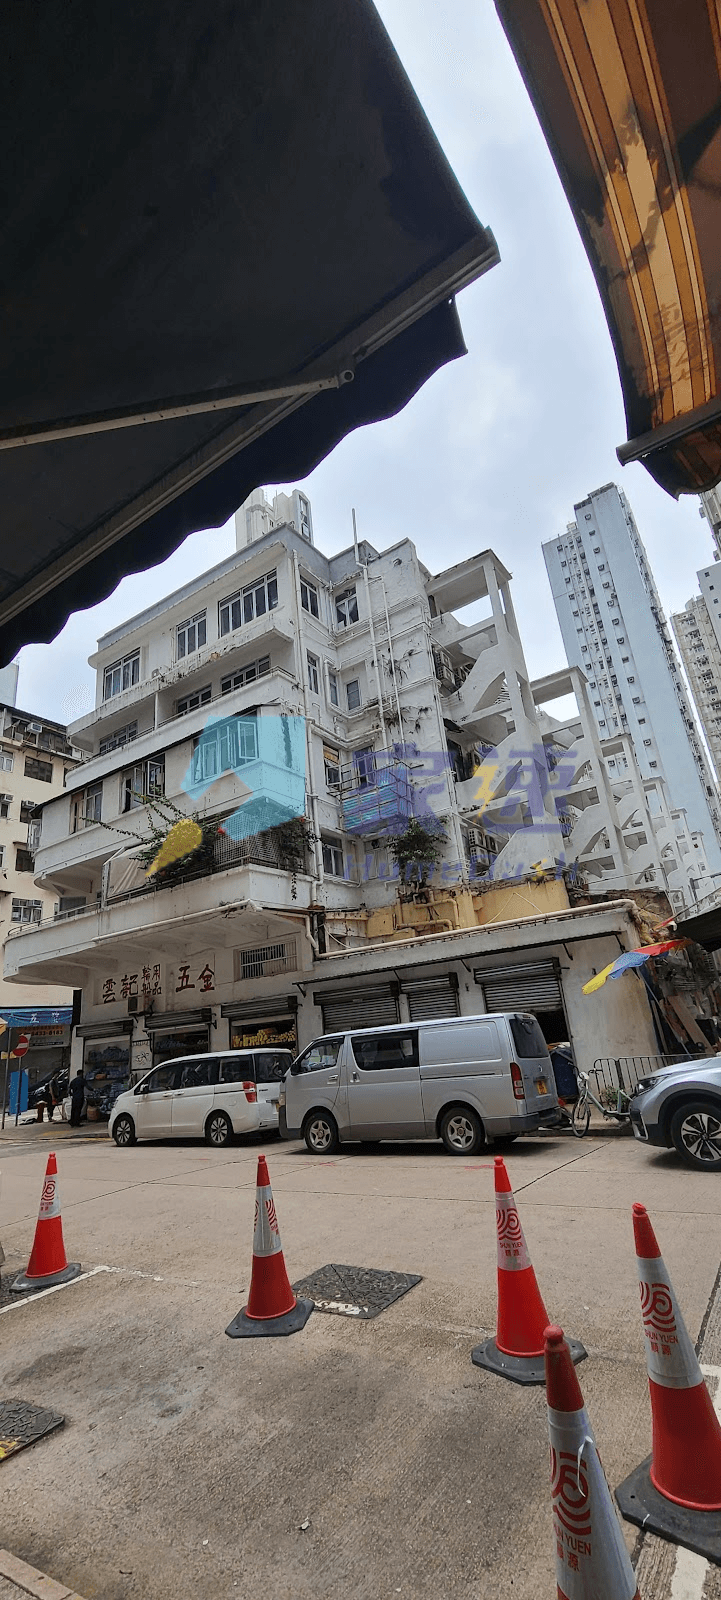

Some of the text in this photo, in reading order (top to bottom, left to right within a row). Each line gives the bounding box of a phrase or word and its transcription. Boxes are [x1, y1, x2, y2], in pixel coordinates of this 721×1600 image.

[175, 963, 215, 993] 五金
[658, 1333, 678, 1344] YUEN
[564, 1532, 592, 1557] YUEN
